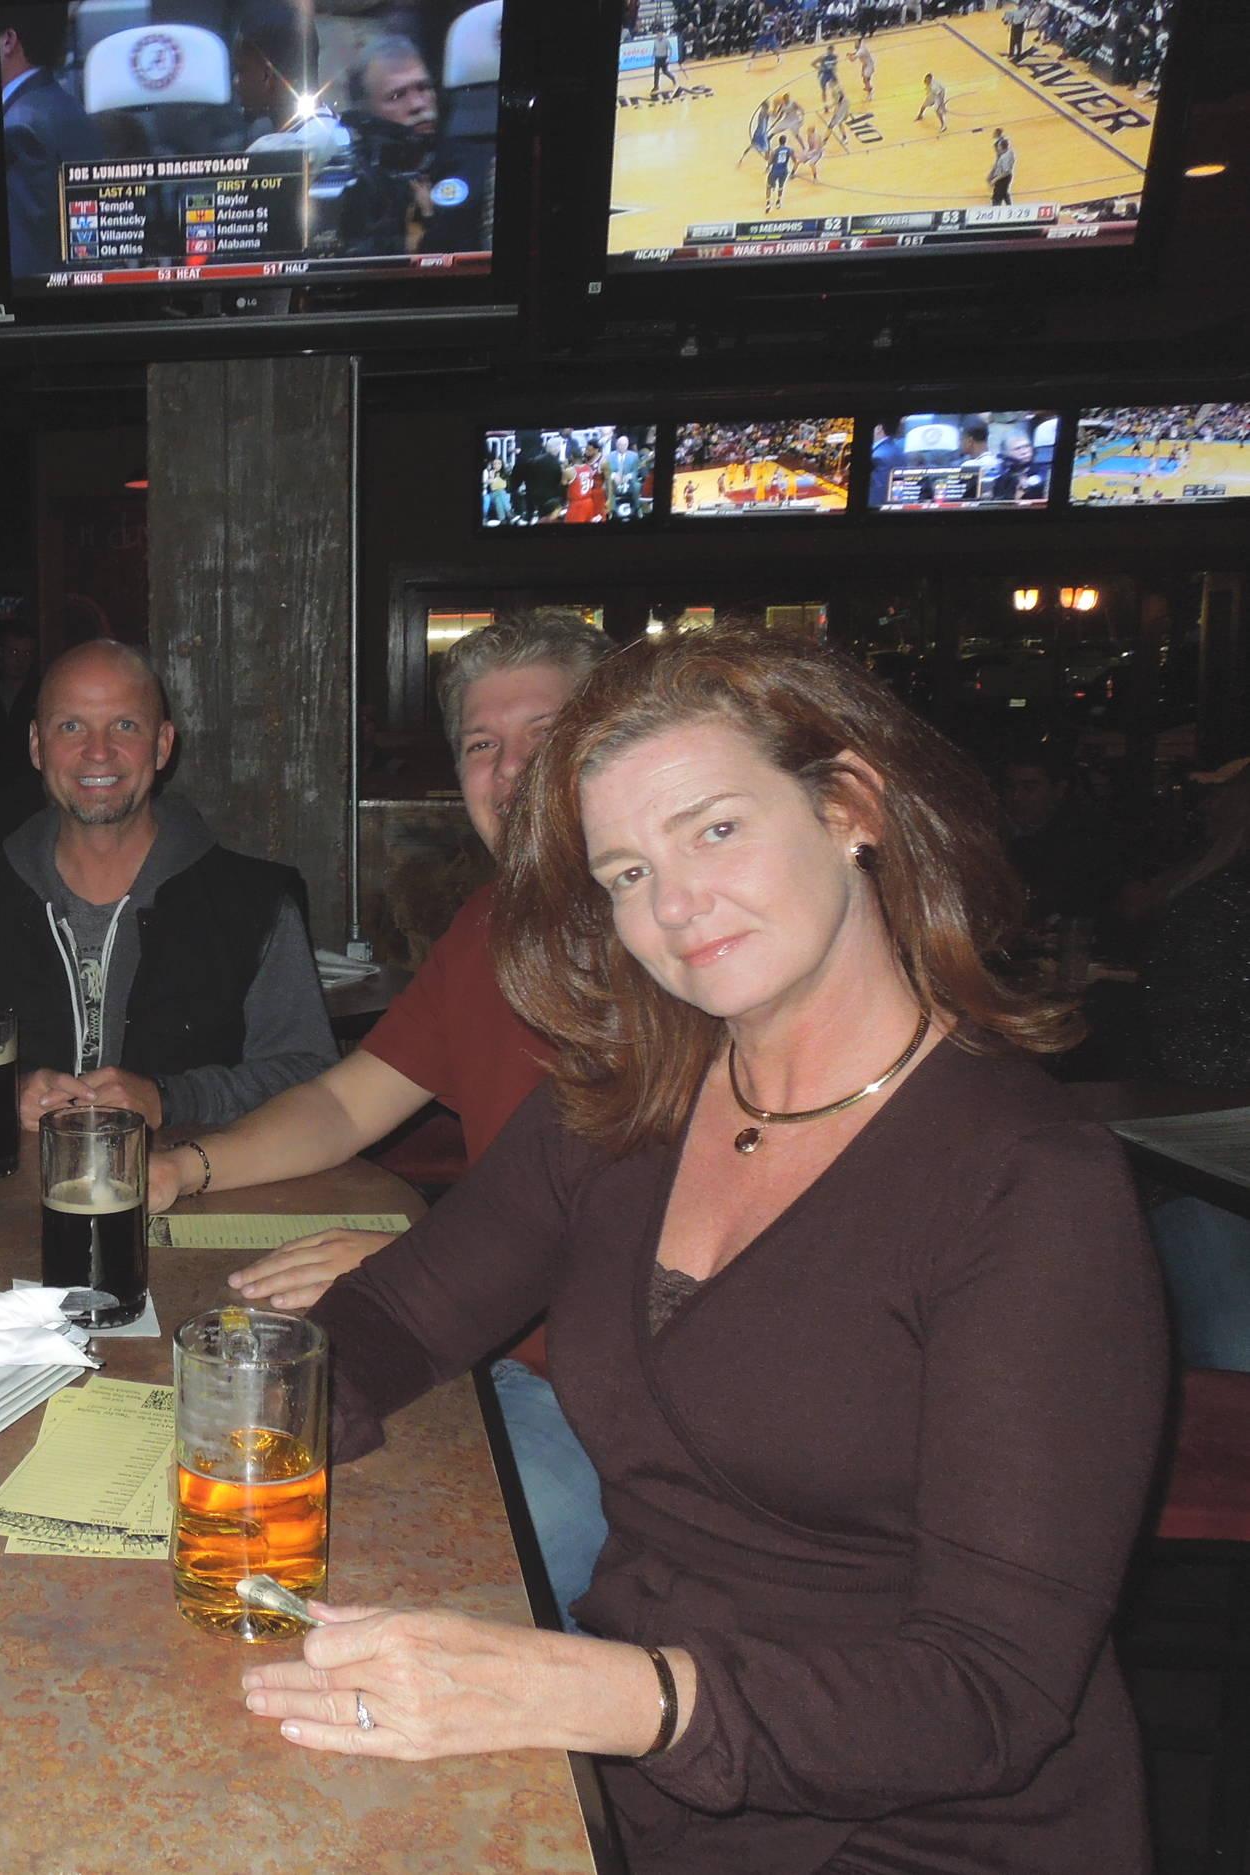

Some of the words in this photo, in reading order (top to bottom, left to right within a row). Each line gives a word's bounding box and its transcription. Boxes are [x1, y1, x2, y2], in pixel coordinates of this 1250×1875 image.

[1008, 46, 1150, 134] XAVIER
[69, 167, 89, 181] JOE
[92, 163, 155, 179] LUNARDI'S
[157, 158, 250, 176] BRACKETOLOGY
[216, 180, 247, 192] FIRST
[251, 179, 258, 190] 4
[261, 177, 283, 189] OUT
[99, 186, 123, 198] LAST
[125, 186, 132, 197] 4
[135, 185, 147, 197] IN
[99, 200, 134, 213] Temple
[217, 194, 249, 207] Baylor
[217, 209, 254, 220] Arizona
[256, 207, 268, 218] St
[100, 214, 147, 227] Kentucky
[759, 221, 803, 233] MEMPHIS
[824, 218, 841, 231] 52
[874, 215, 910, 227] XAVIER
[942, 211, 959, 223] 53
[976, 210, 994, 220] 2nd
[217, 223, 254, 234] Indiana
[256, 222, 268, 233] St
[100, 230, 144, 240] Villanova
[100, 245, 118, 255] Ole
[119, 244, 143, 255] Miss
[217, 239, 260, 250] Alabama
[733, 244, 762, 257] WAKE
[764, 246, 774, 255] vs
[775, 242, 815, 254] FLORIDA
[818, 241, 830, 252] ST
[73, 273, 103, 285] KINGS
[176, 268, 200, 280] HEAT
[285, 262, 309, 273] HALF
